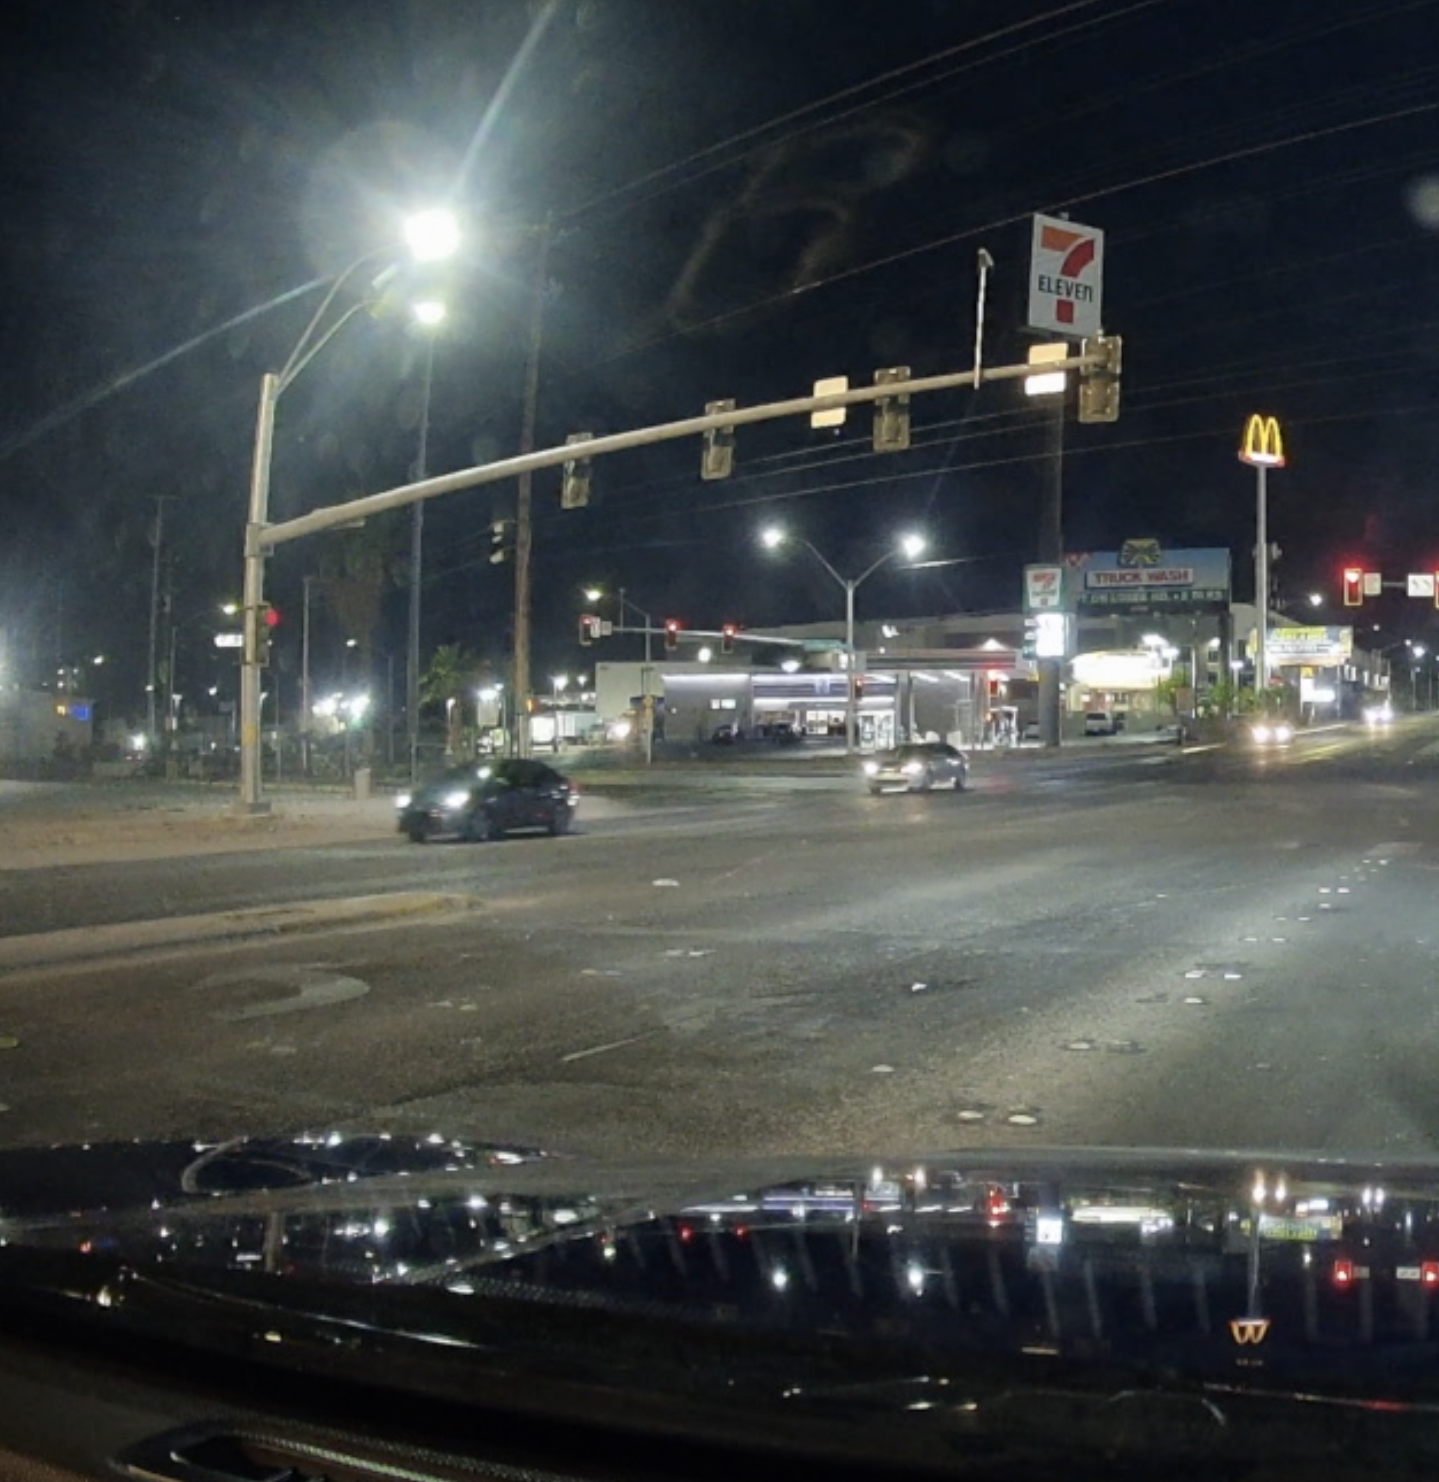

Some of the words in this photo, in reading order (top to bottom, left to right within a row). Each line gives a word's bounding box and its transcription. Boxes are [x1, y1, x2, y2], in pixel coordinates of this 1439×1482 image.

[1041, 225, 1095, 324] 7
[1093, 572, 1142, 585] TRUCK
[1147, 570, 1189, 583] WASH
